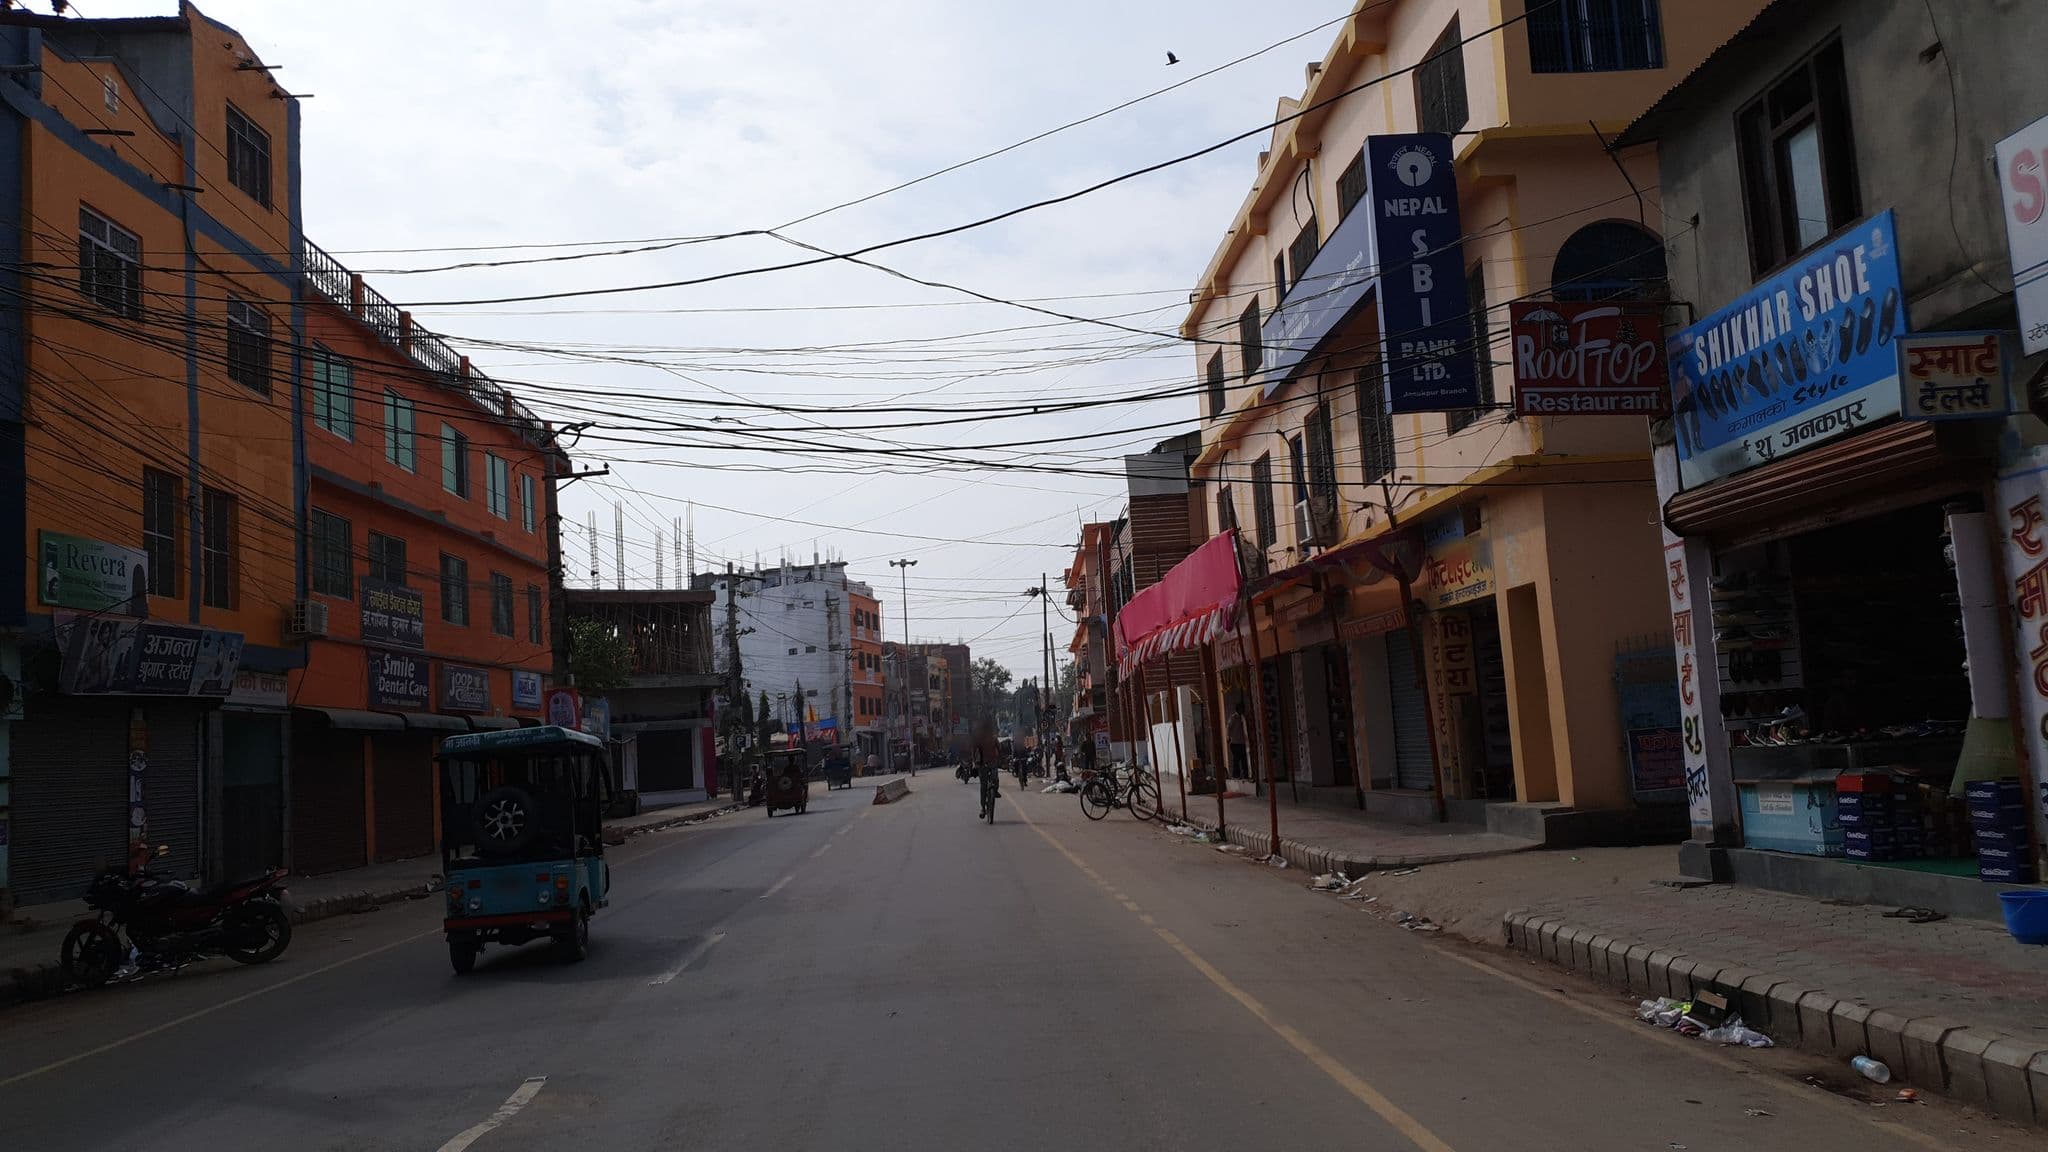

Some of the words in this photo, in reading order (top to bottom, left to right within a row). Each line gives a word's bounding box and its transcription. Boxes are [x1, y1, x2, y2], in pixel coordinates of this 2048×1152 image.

[1384, 196, 1449, 218] NEPAL
[1695, 289, 1793, 377] SHIKHAR
[1799, 243, 1871, 322] SHOE
[1907, 335, 1998, 378] स्मार्ट
[1413, 362, 1451, 382] LTD.
[1523, 392, 1660, 414] Restaurant
[1793, 374, 1849, 405] Style
[1780, 397, 1868, 450] जनकपुर
[66, 543, 126, 579] Revera
[383, 653, 416, 679] Smile
[377, 677, 409, 695] Dental
[409, 680, 429, 698] Care
